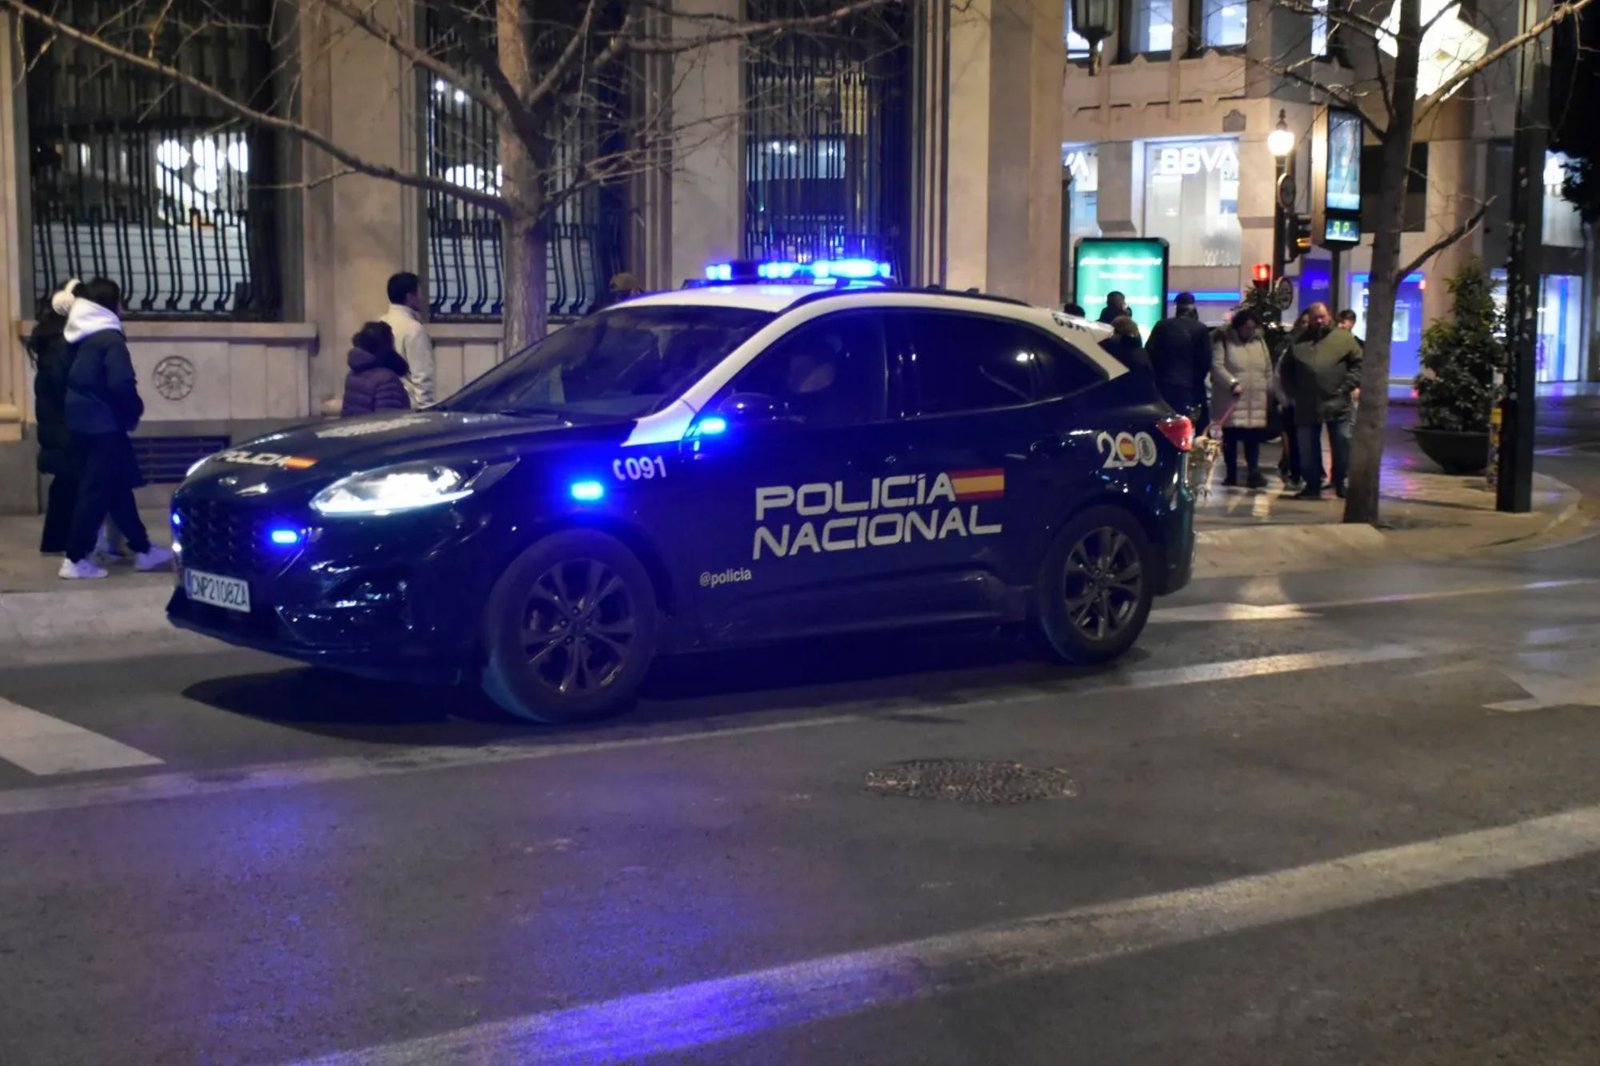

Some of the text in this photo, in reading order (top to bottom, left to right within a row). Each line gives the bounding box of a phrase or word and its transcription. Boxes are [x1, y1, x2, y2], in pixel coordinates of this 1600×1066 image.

[1161, 142, 1239, 175] BBVA
[752, 505, 1002, 560] NACIONAL
[699, 567, 752, 588] @policia
